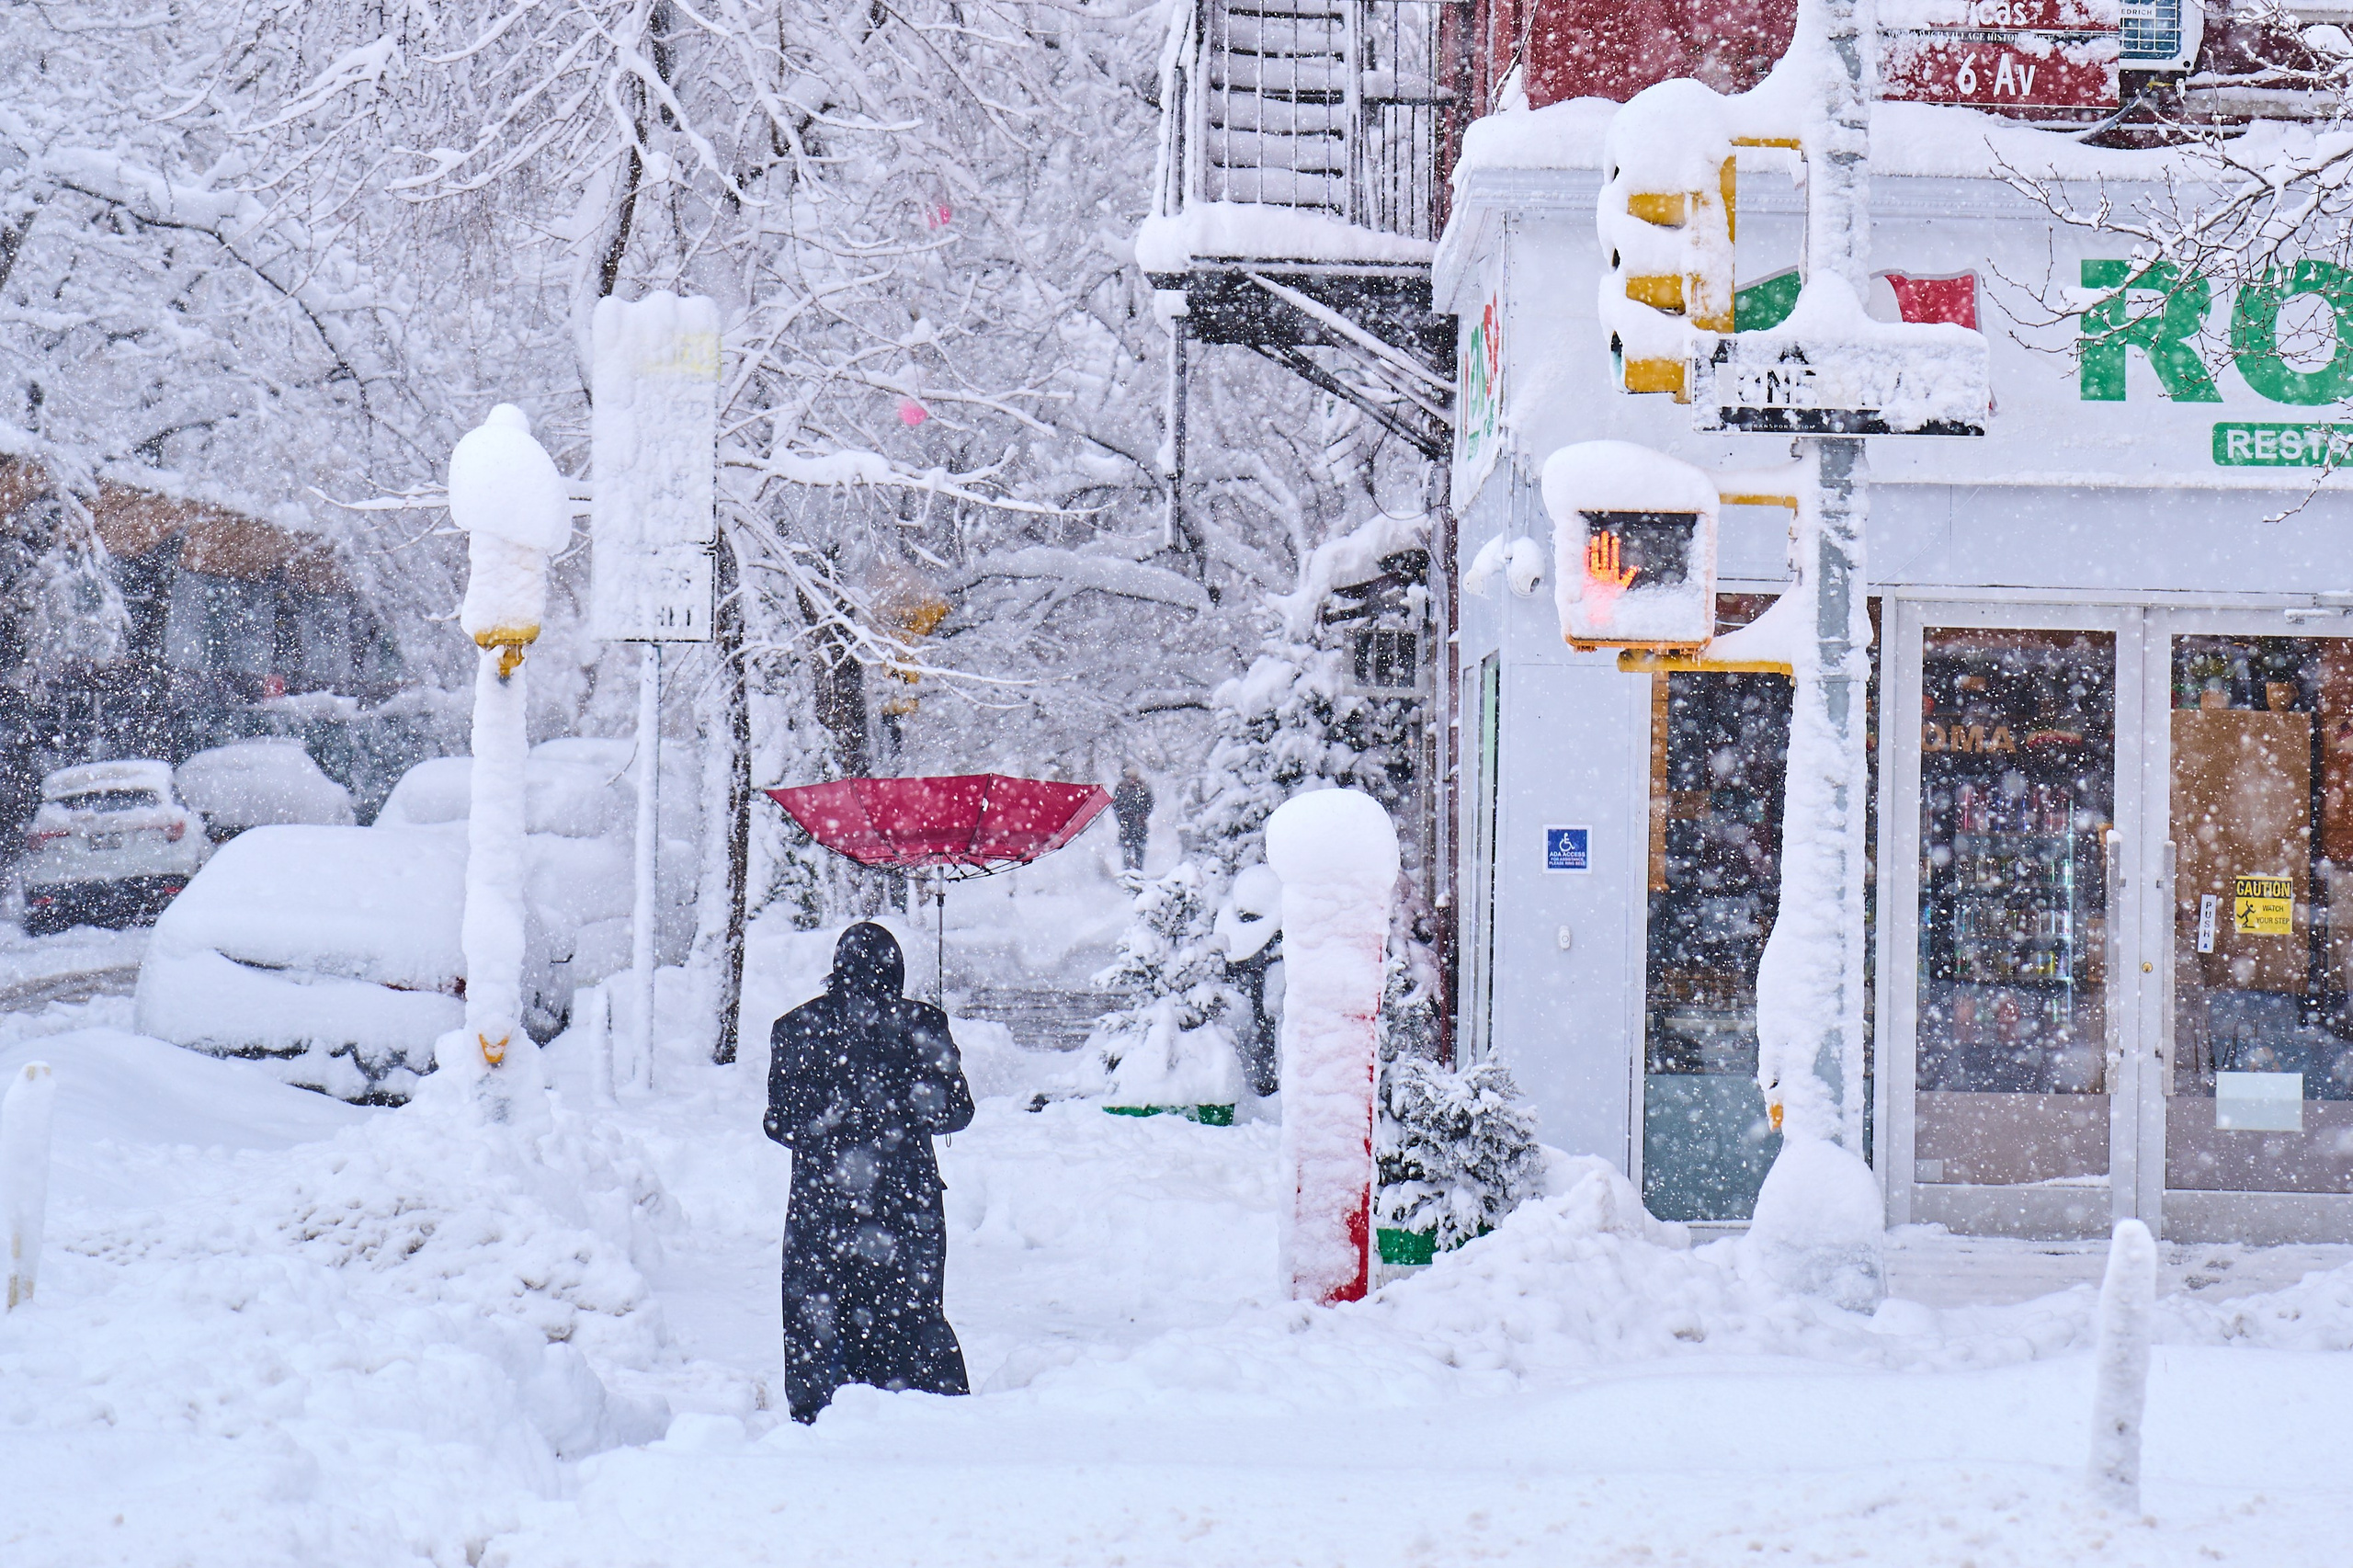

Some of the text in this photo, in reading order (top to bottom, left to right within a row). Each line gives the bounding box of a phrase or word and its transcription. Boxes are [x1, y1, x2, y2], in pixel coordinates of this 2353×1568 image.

[1958, 51, 2036, 97] 6 Av
[2080, 258, 2353, 407] RO
[1921, 723, 2018, 753] OMA
[2236, 880, 2290, 897] CAUTION
[2203, 901, 2212, 937] PUSH
[2256, 916, 2273, 925] YOUR
[2262, 904, 2284, 913] WATCH
